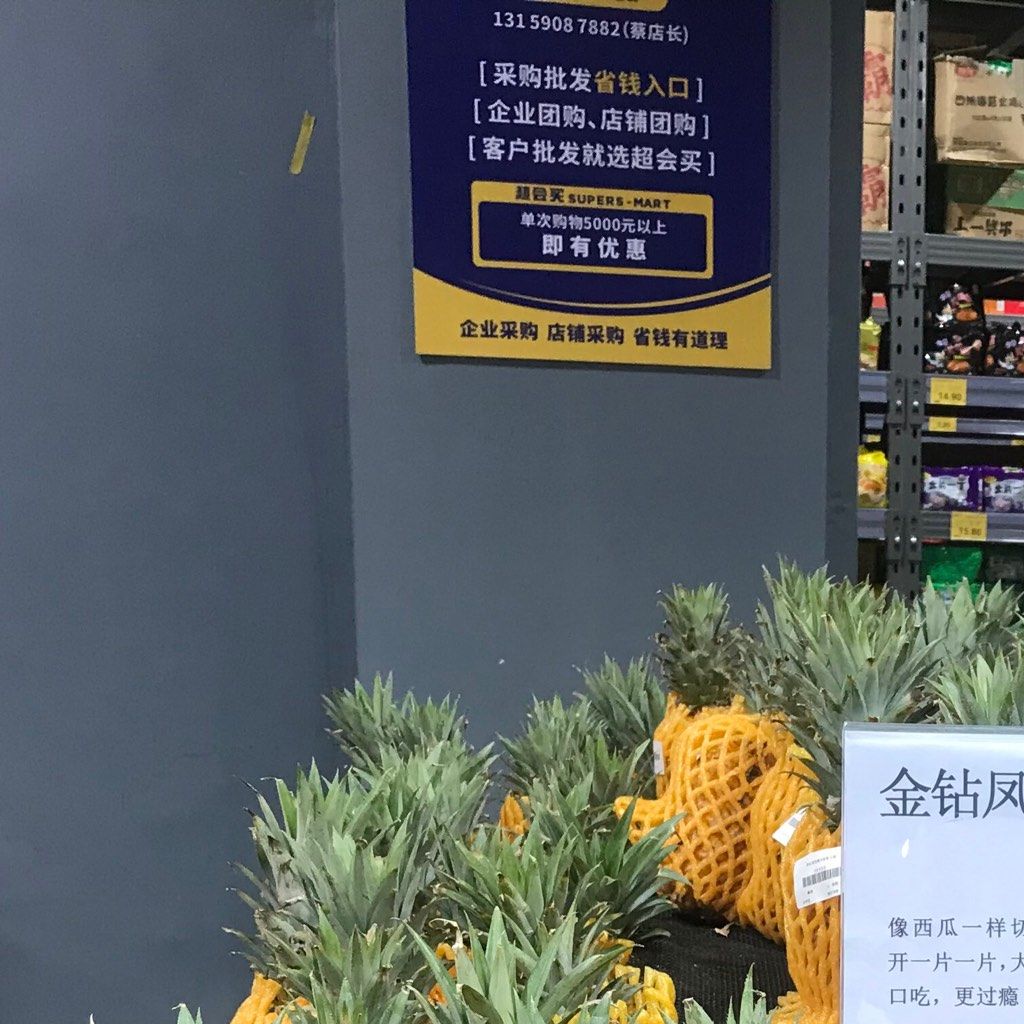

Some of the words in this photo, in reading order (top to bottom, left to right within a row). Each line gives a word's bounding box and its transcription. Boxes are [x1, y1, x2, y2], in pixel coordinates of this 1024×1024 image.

[520, 211, 668, 235] 单次购物5000元以上
[541, 234, 647, 261] 即有优惠
[460, 320, 538, 341] 企业采购
[547, 324, 625, 345] 店铺采购
[633, 326, 728, 350] 省钱有道理
